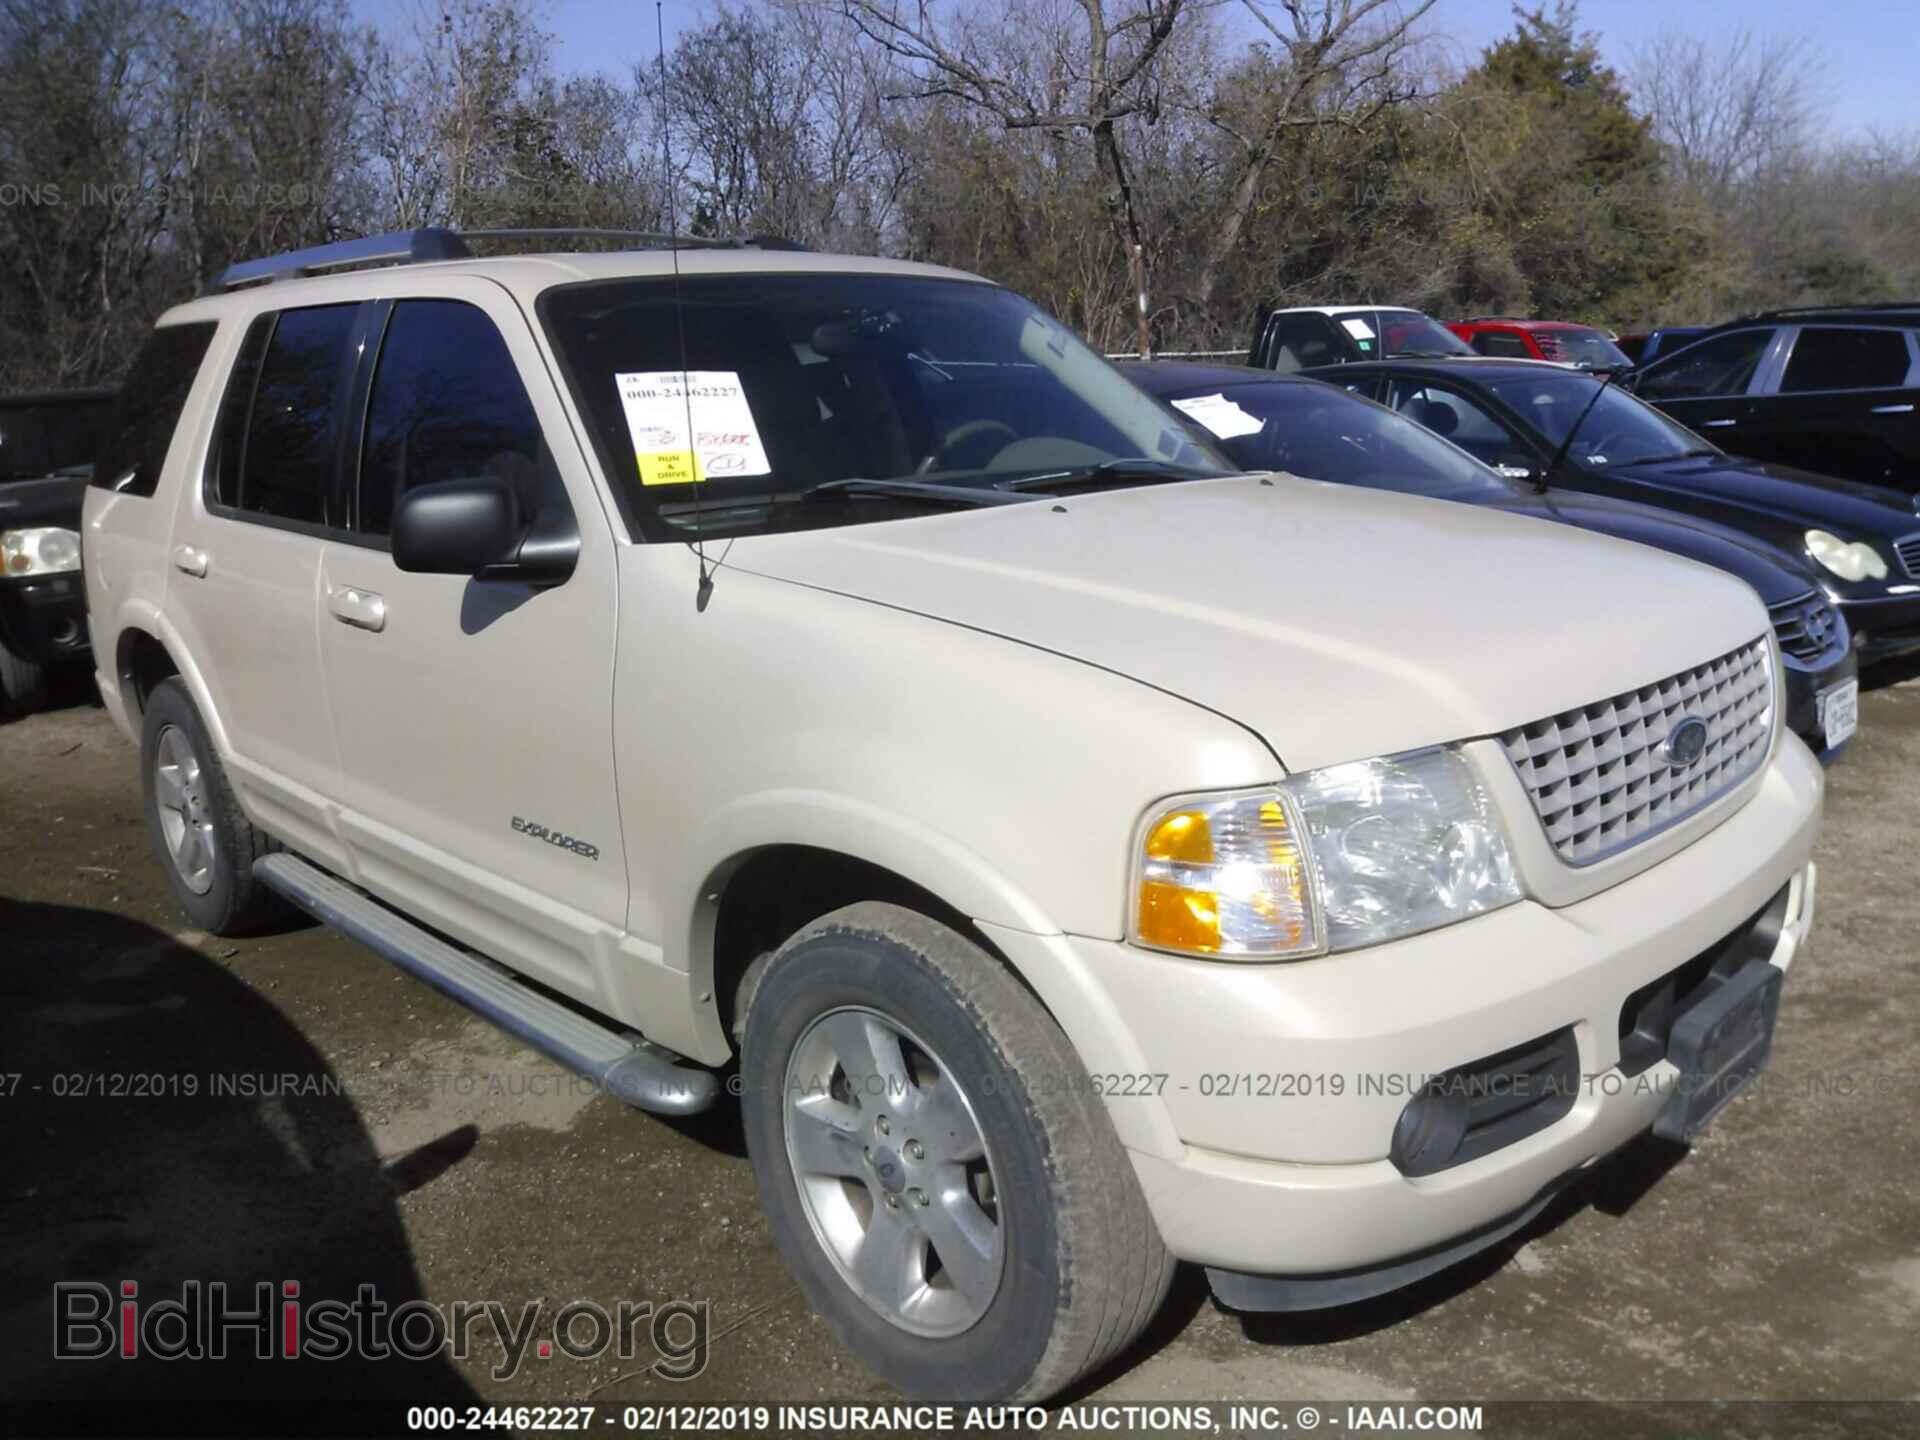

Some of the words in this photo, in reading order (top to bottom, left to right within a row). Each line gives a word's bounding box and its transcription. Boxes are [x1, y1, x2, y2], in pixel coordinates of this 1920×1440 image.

[657, 455, 680, 463] RUN
[657, 470, 688, 480] DRIVE
[511, 815, 600, 861] EXPLORER
